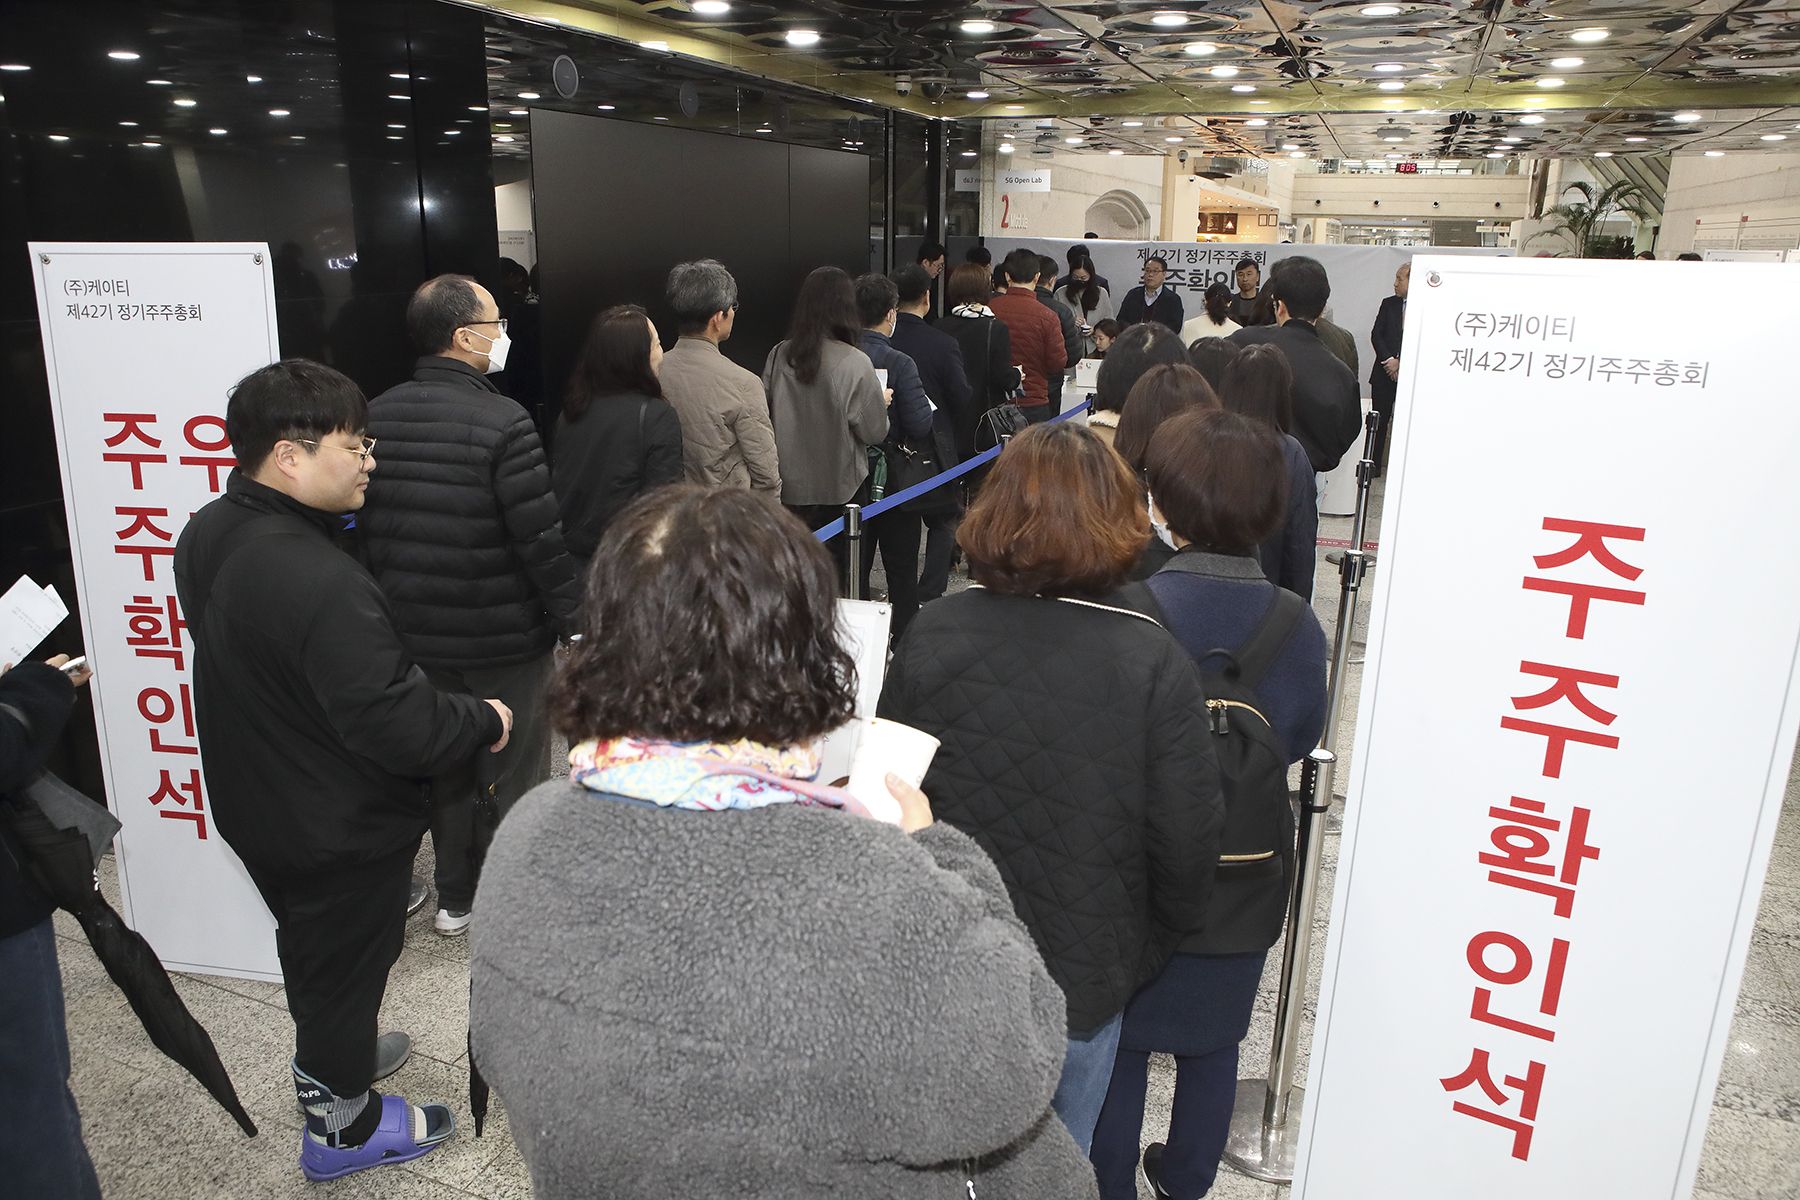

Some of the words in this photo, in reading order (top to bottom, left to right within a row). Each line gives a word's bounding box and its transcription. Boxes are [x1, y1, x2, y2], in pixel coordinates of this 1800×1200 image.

[1014, 177, 1031, 185] Open
[1001, 194, 1009, 229] 2
[63, 279, 130, 297] (주)케이티
[66, 303, 113, 321] 제42기
[117, 303, 202, 322] 정기주주총회
[1454, 311, 1576, 343] (주)케이티
[1449, 347, 1534, 378] 제42기
[1543, 352, 1710, 389] 정기주주총회
[103, 412, 208, 840] 주주확인석
[1440, 516, 1647, 1162] 주주확인석
